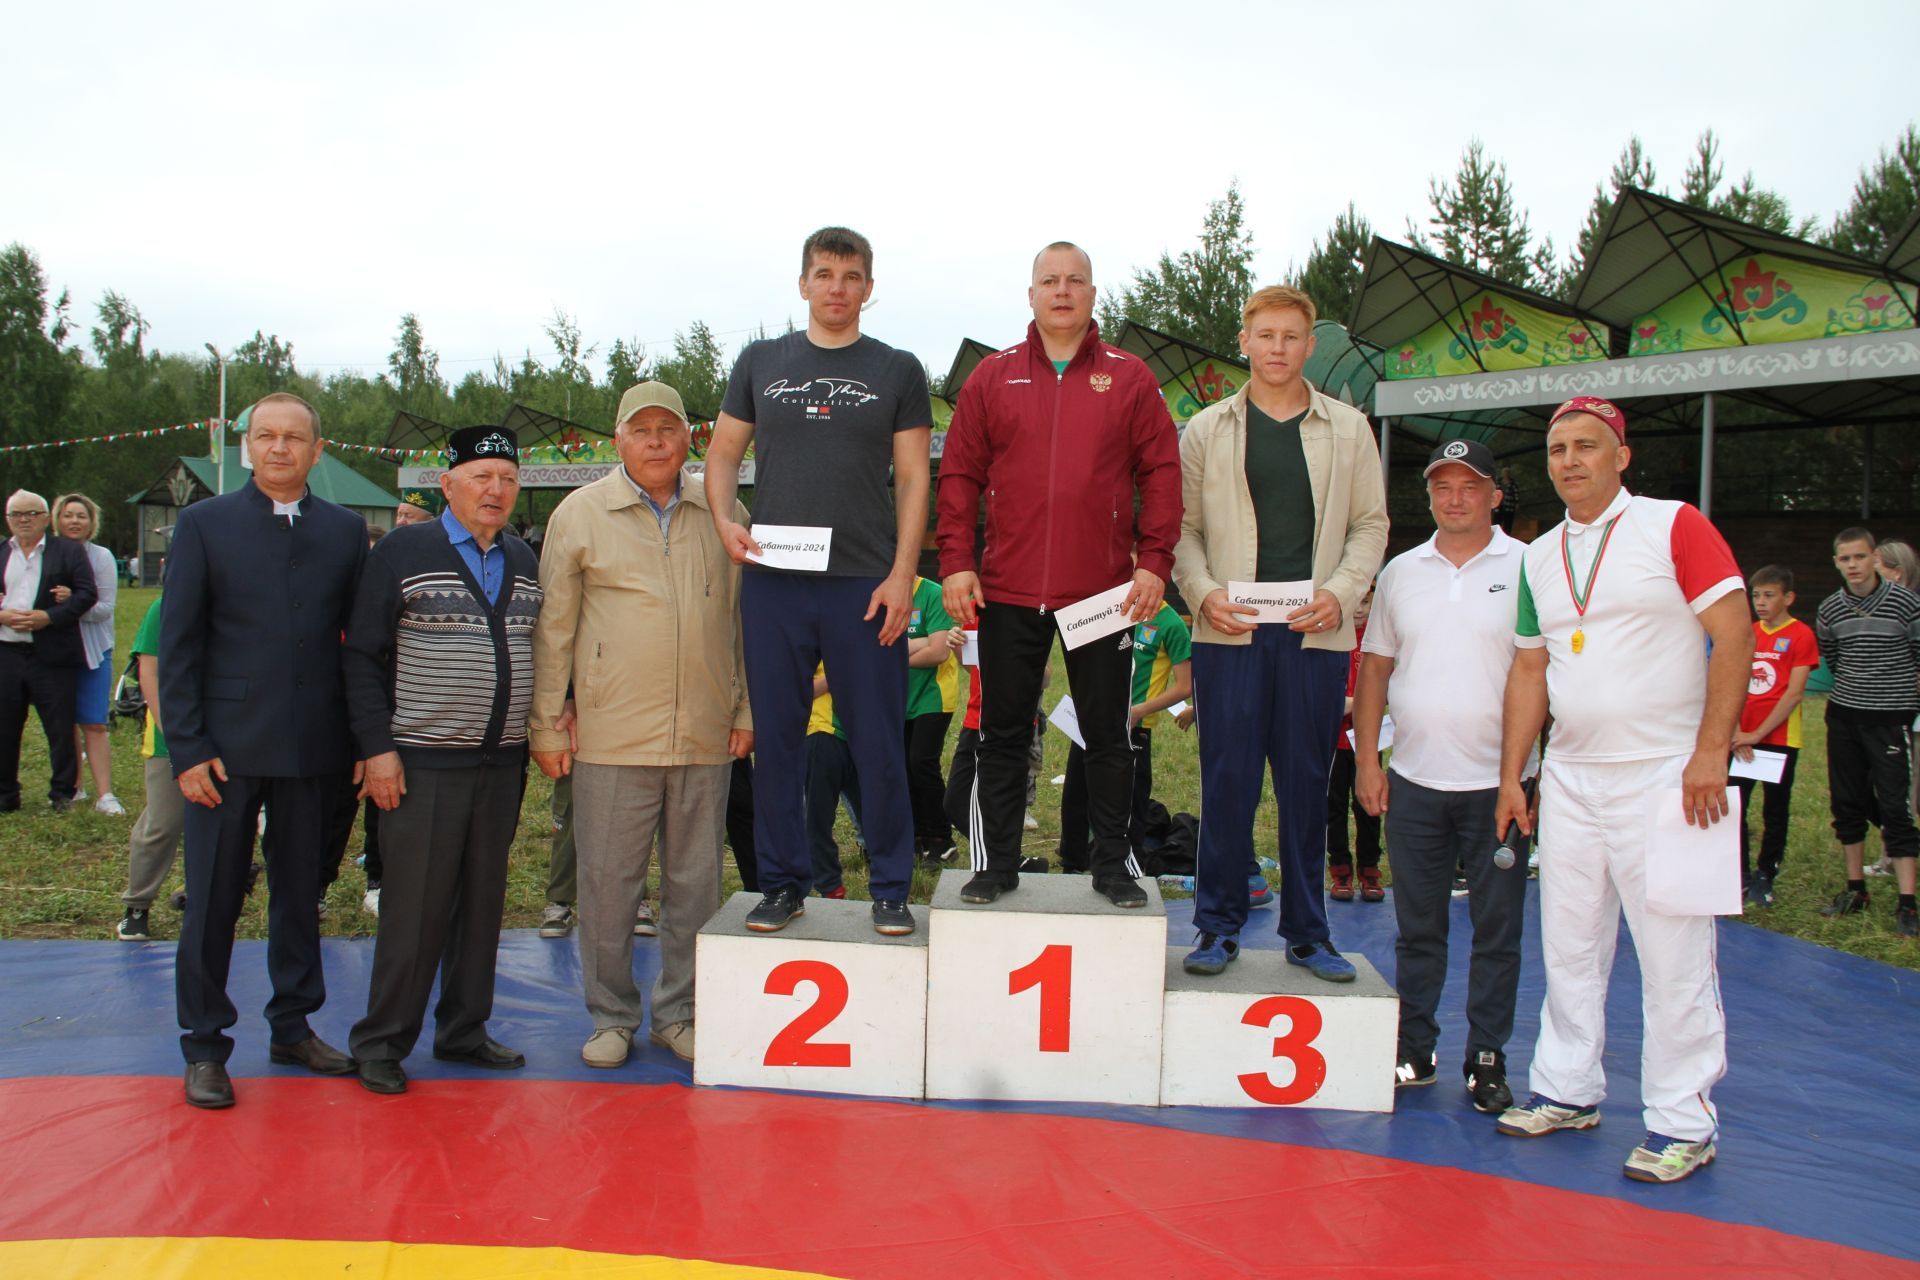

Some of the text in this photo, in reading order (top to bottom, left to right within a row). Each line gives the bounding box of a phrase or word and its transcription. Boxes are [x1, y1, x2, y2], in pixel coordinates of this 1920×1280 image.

[782, 397, 860, 407] Collective
[757, 541, 825, 552] Сабантуй 2024
[1234, 595, 1308, 608] Сабантуй 2024
[1066, 606, 1113, 632] Сабантуй
[1008, 944, 1073, 1053] 1
[762, 959, 851, 1068] 2
[1237, 995, 1327, 1106] 3
